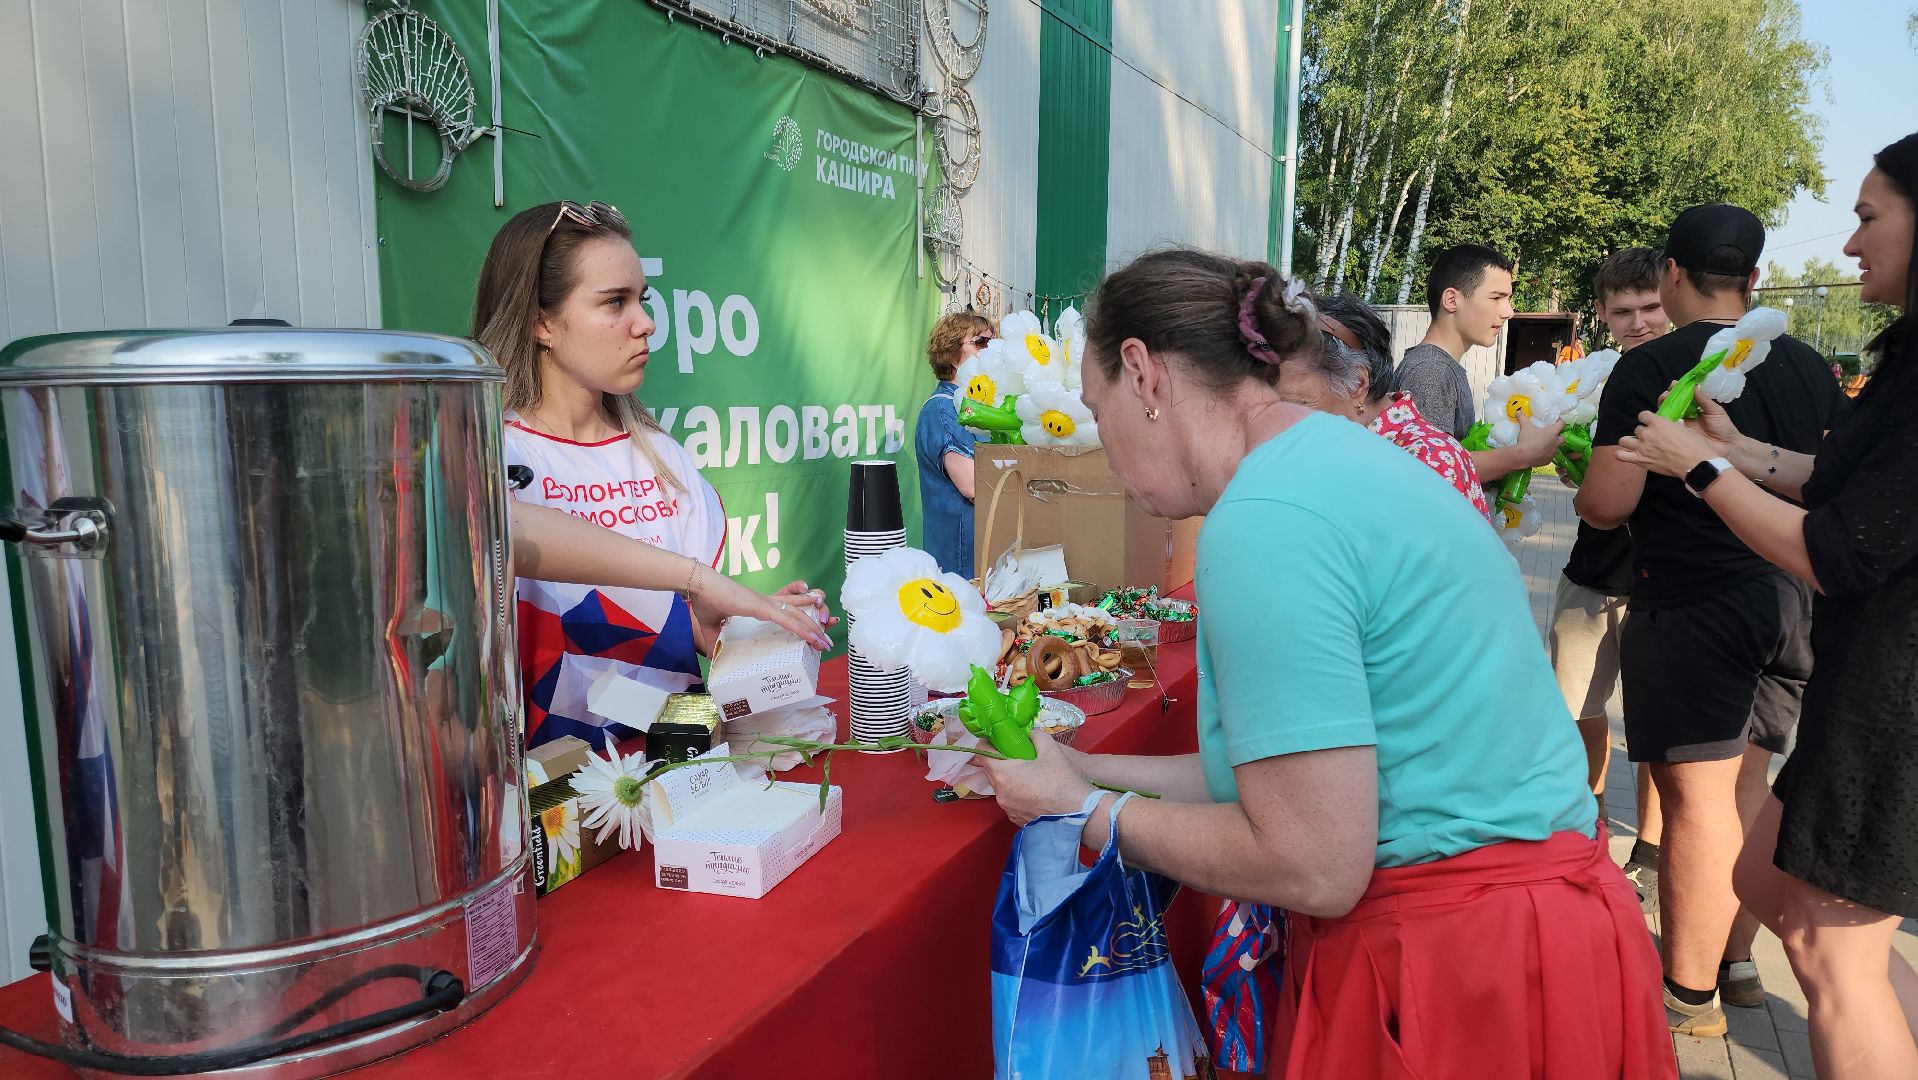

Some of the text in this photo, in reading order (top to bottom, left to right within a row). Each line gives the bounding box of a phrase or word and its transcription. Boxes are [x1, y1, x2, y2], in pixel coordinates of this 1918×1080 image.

[816, 129, 897, 170] ГОРОДСКОЙ
[816, 157, 896, 200] КАШИРА
[638, 257, 760, 374] бро
[650, 403, 906, 470] аловать
[532, 826, 546, 887] Greenfield
